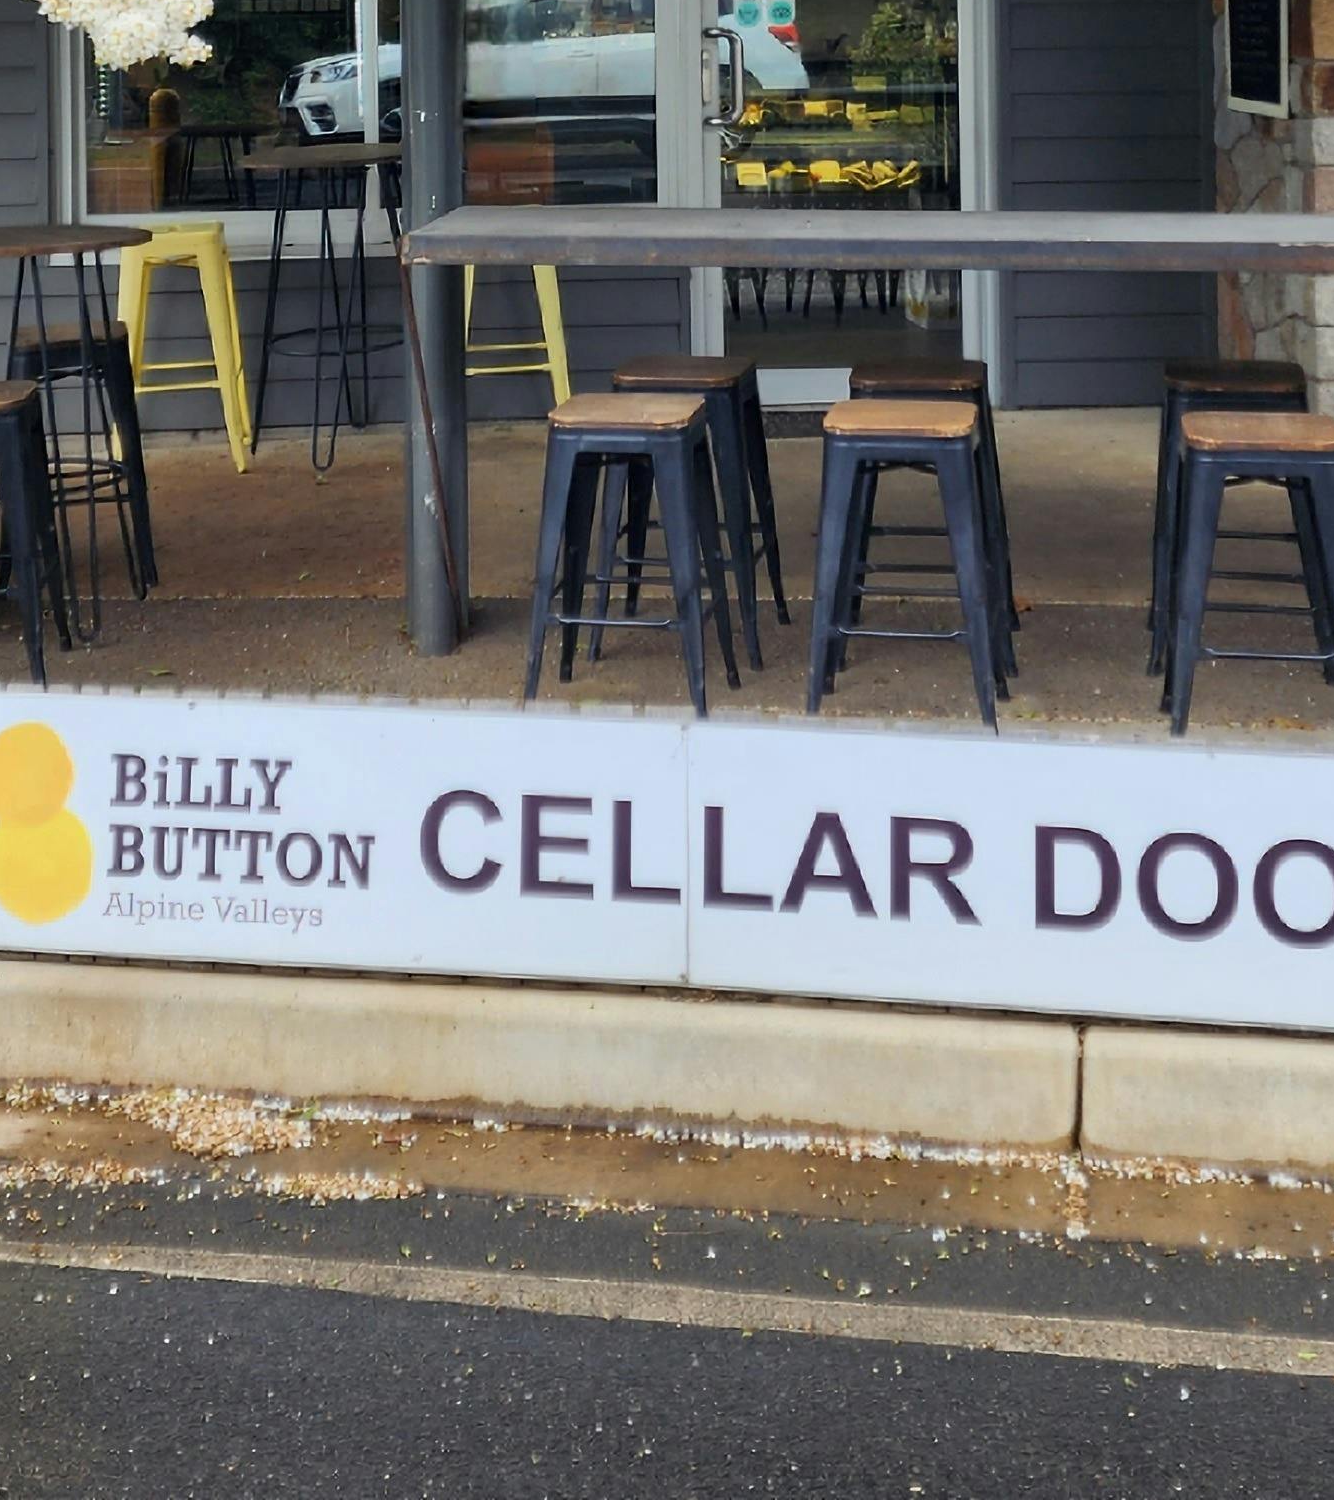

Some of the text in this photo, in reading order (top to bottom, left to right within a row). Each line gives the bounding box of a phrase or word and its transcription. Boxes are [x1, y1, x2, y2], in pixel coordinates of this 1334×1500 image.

[106, 823, 375, 890] BUTTON
[420, 789, 982, 927] CELLAR
[103, 891, 323, 934] Alpine Valleys
